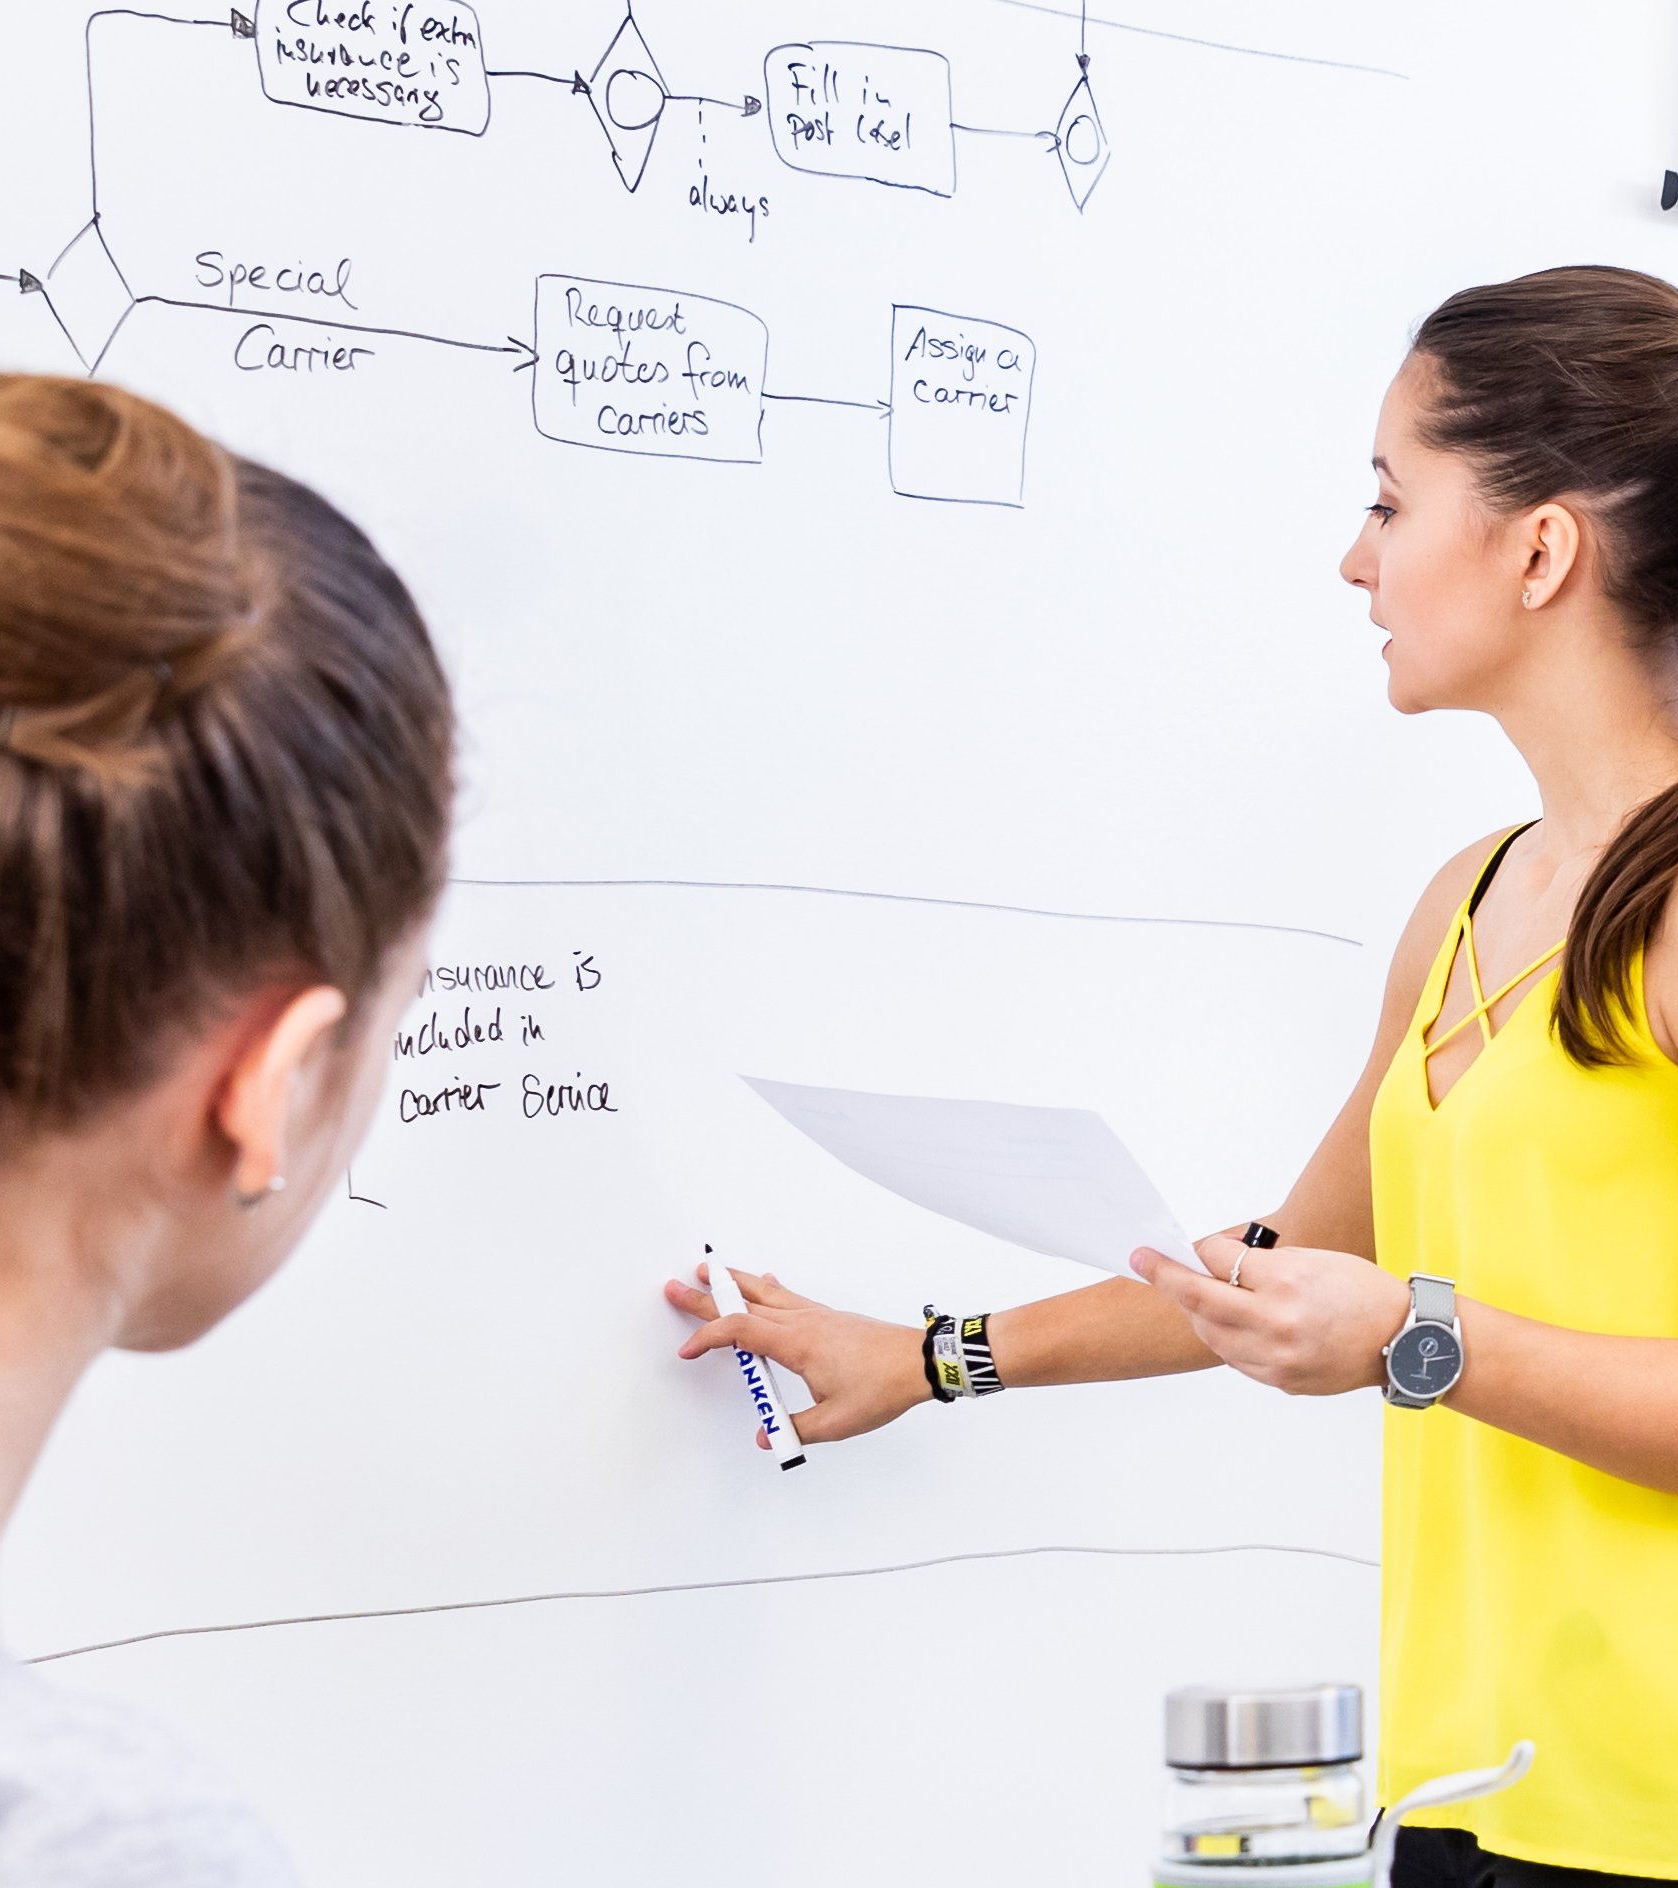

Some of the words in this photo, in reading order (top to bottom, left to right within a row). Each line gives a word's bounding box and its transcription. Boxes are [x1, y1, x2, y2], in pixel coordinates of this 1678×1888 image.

[285, 0, 378, 37] Check
[390, 1, 416, 47] if
[273, 23, 424, 80] insurance
[428, 50, 462, 87] is
[785, 61, 841, 107] Fill
[784, 109, 836, 152] Post
[687, 173, 771, 245] always
[190, 249, 360, 314] Special
[560, 282, 690, 354] Request
[232, 320, 379, 376] Carrier
[554, 343, 671, 412] quotes
[680, 339, 752, 402] from
[903, 325, 1002, 381] Assign
[995, 348, 1023, 374] a
[570, 949, 603, 993] is
[518, 1013, 547, 1048] in
[520, 1070, 620, 1120] Service
